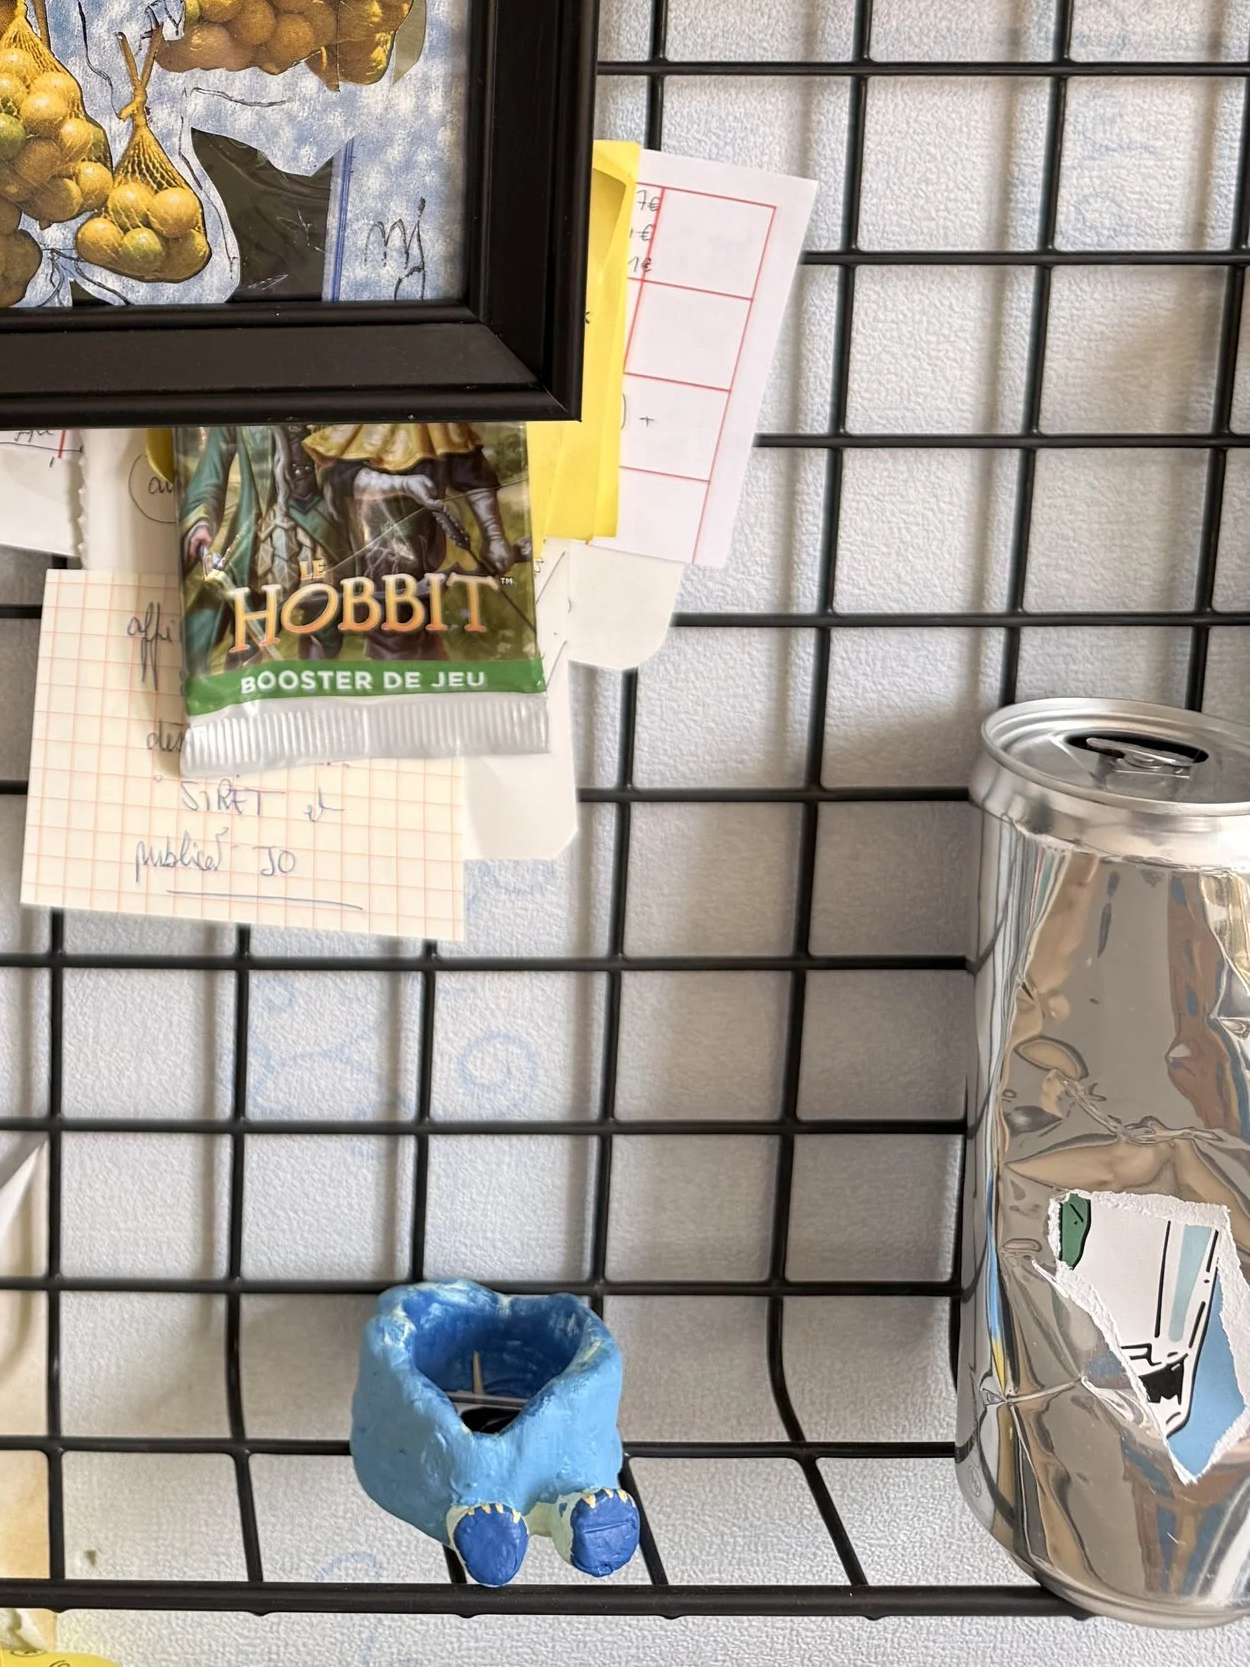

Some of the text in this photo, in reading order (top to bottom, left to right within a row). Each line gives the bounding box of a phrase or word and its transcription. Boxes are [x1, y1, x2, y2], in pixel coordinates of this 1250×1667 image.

[300, 559, 326, 581] LE
[228, 572, 500, 654] HOBBIT
[240, 669, 486, 695] BOOSTER DE JEU
